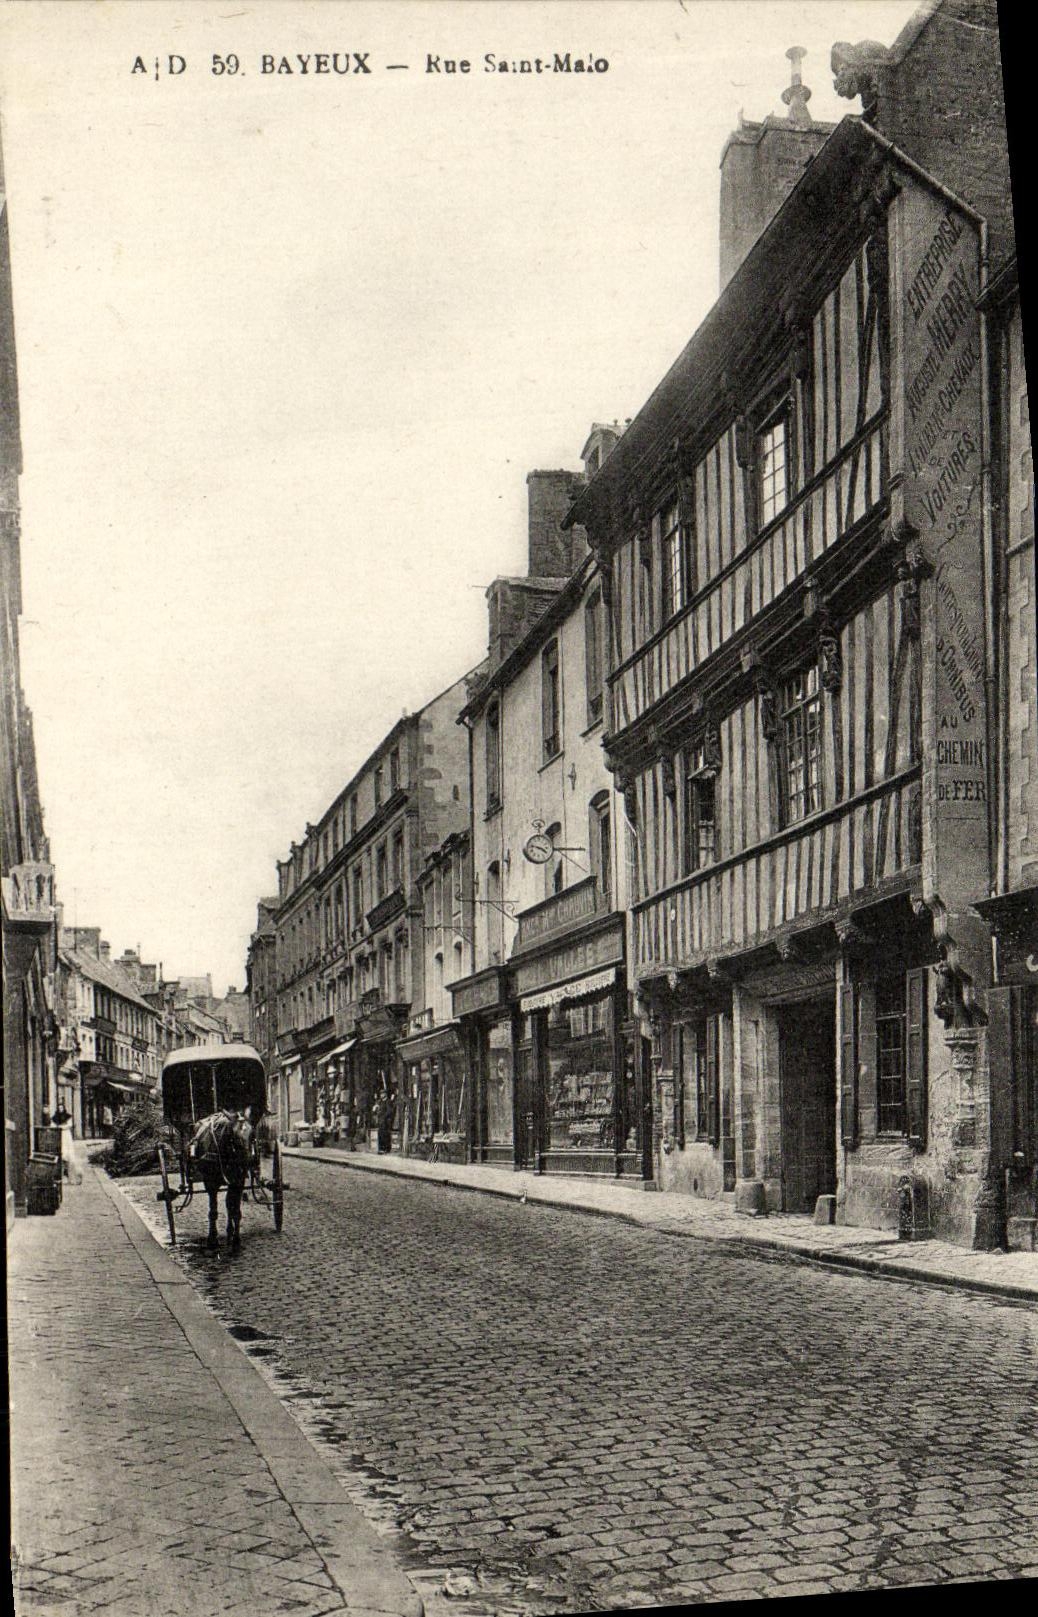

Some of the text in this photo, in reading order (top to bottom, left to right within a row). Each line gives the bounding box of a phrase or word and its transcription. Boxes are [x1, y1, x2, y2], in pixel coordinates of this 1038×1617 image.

[907, 211, 962, 324] ENTREPRISE
[920, 430, 975, 527] VOITURES
[940, 715, 959, 729] AU
[937, 739, 985, 768] CHEMIN
[938, 779, 987, 801] DE FER
